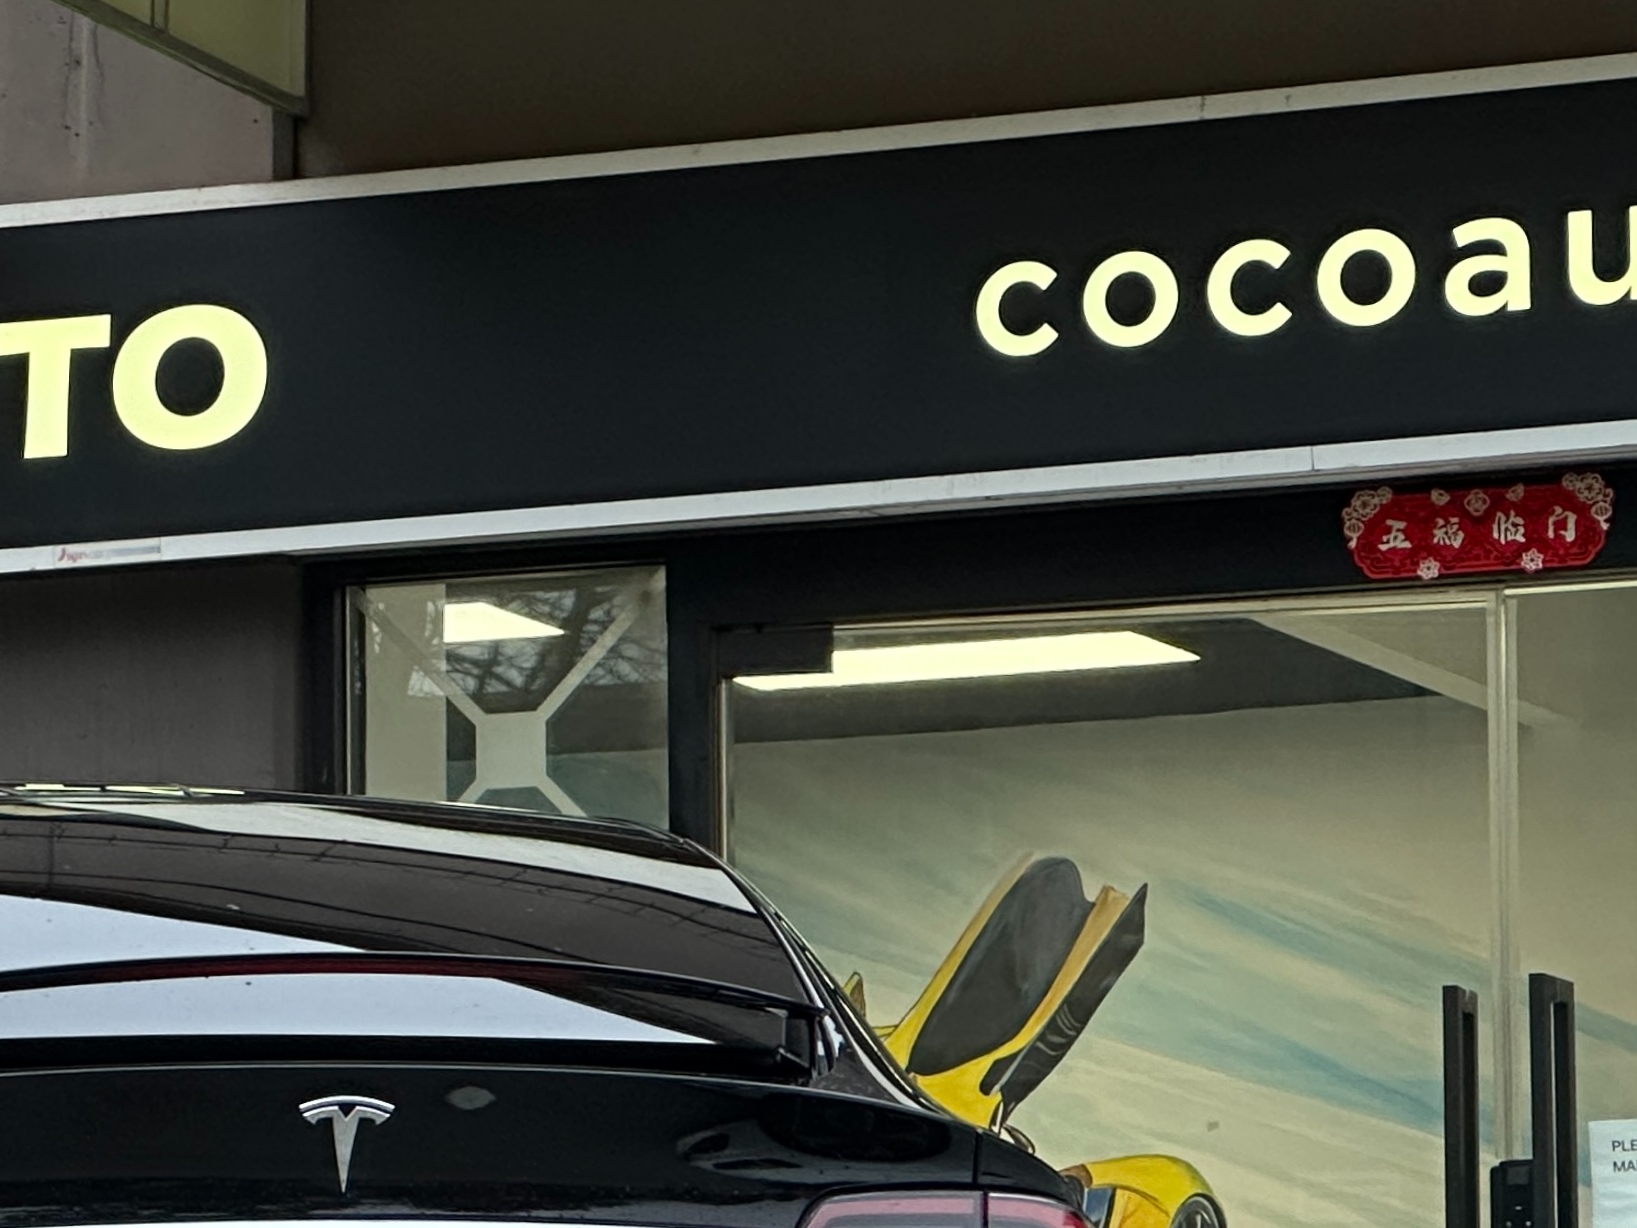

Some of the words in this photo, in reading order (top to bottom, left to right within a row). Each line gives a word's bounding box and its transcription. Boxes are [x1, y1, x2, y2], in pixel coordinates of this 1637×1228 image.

[975, 205, 1637, 357] cocoau
[1377, 504, 1578, 552] 五福临门
